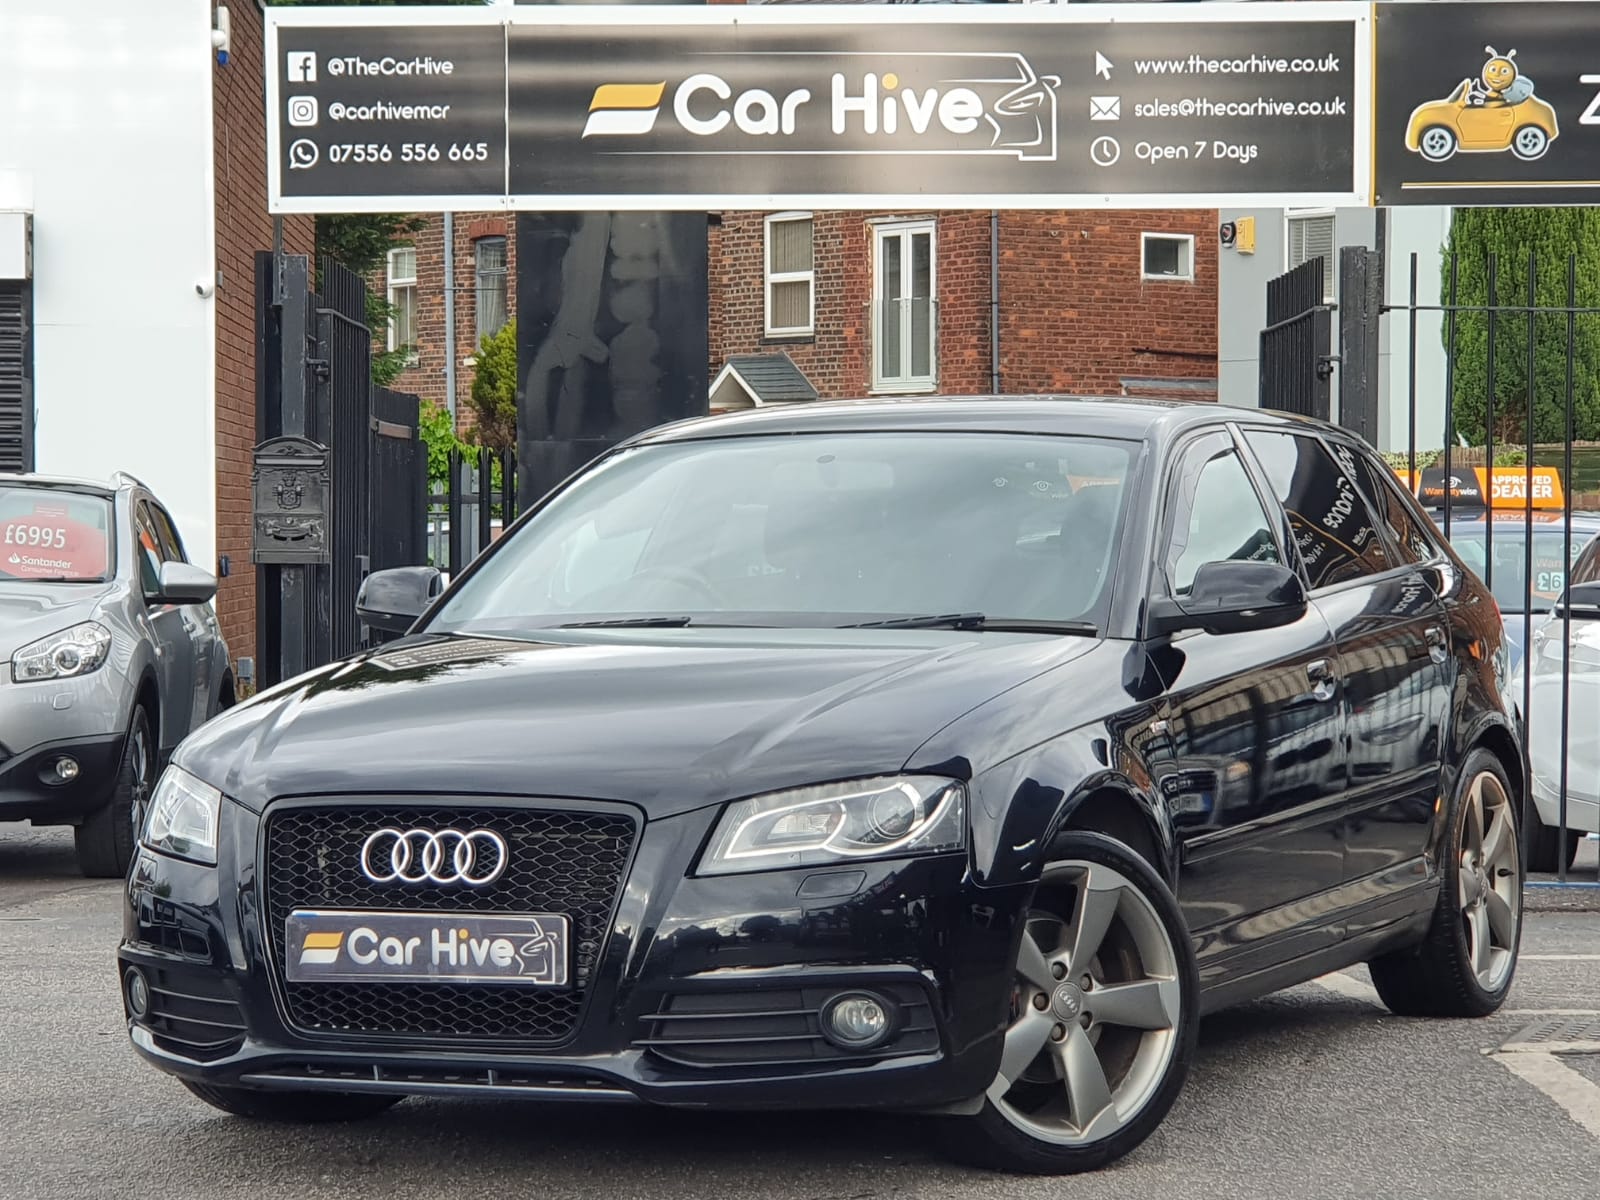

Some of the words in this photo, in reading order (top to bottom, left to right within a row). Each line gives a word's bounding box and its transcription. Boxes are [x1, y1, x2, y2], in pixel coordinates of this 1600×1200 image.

[327, 57, 454, 76] @TheCarHive
[1134, 53, 1340, 74] www.thecarhive.co.uk
[328, 101, 450, 121] @carhivemcr
[673, 72, 811, 135] Car
[831, 72, 984, 135] Hive
[1134, 96, 1346, 117] sales@thecarhive.co.uk
[329, 144, 392, 162] 07556
[400, 143, 440, 162] 556
[448, 143, 488, 161] 665
[1134, 142, 1188, 164] Open
[1193, 141, 1207, 159] 7
[1213, 141, 1258, 164] Days
[1424, 487, 1478, 497] Warrtywise
[5, 524, 66, 548] £6995
[21, 555, 72, 569] Santander
[347, 927, 421, 966] Car
[431, 927, 515, 967] Hive
